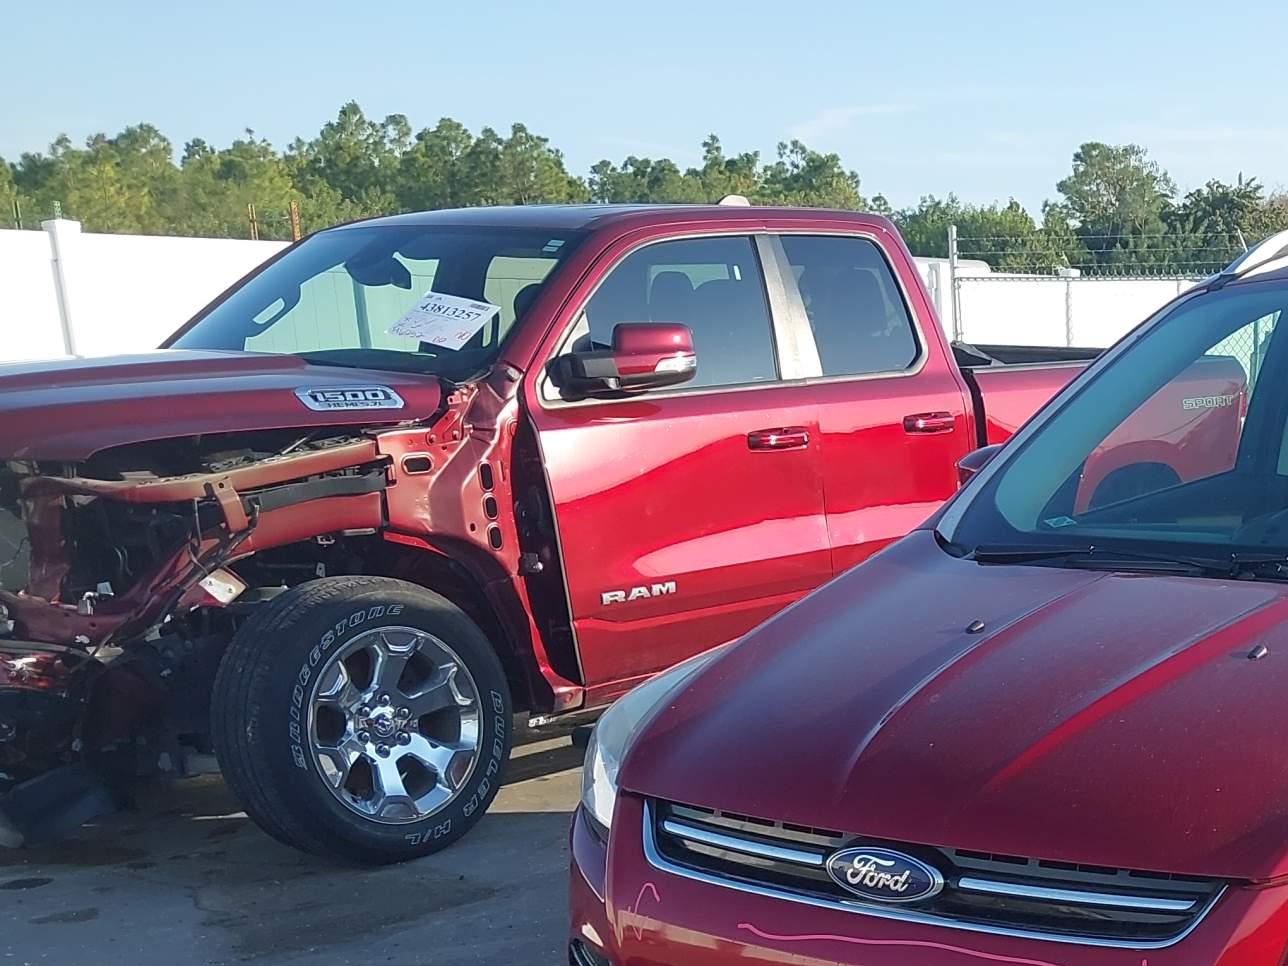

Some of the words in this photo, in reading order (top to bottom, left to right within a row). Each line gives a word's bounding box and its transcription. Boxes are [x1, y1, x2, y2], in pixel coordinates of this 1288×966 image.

[420, 302, 482, 321] 43813257
[308, 391, 385, 402] 1500
[1183, 395, 1234, 410] SPORT
[601, 581, 677, 605] RAM
[289, 604, 404, 771] BRIDGESTONE
[846, 854, 911, 892] Ford
